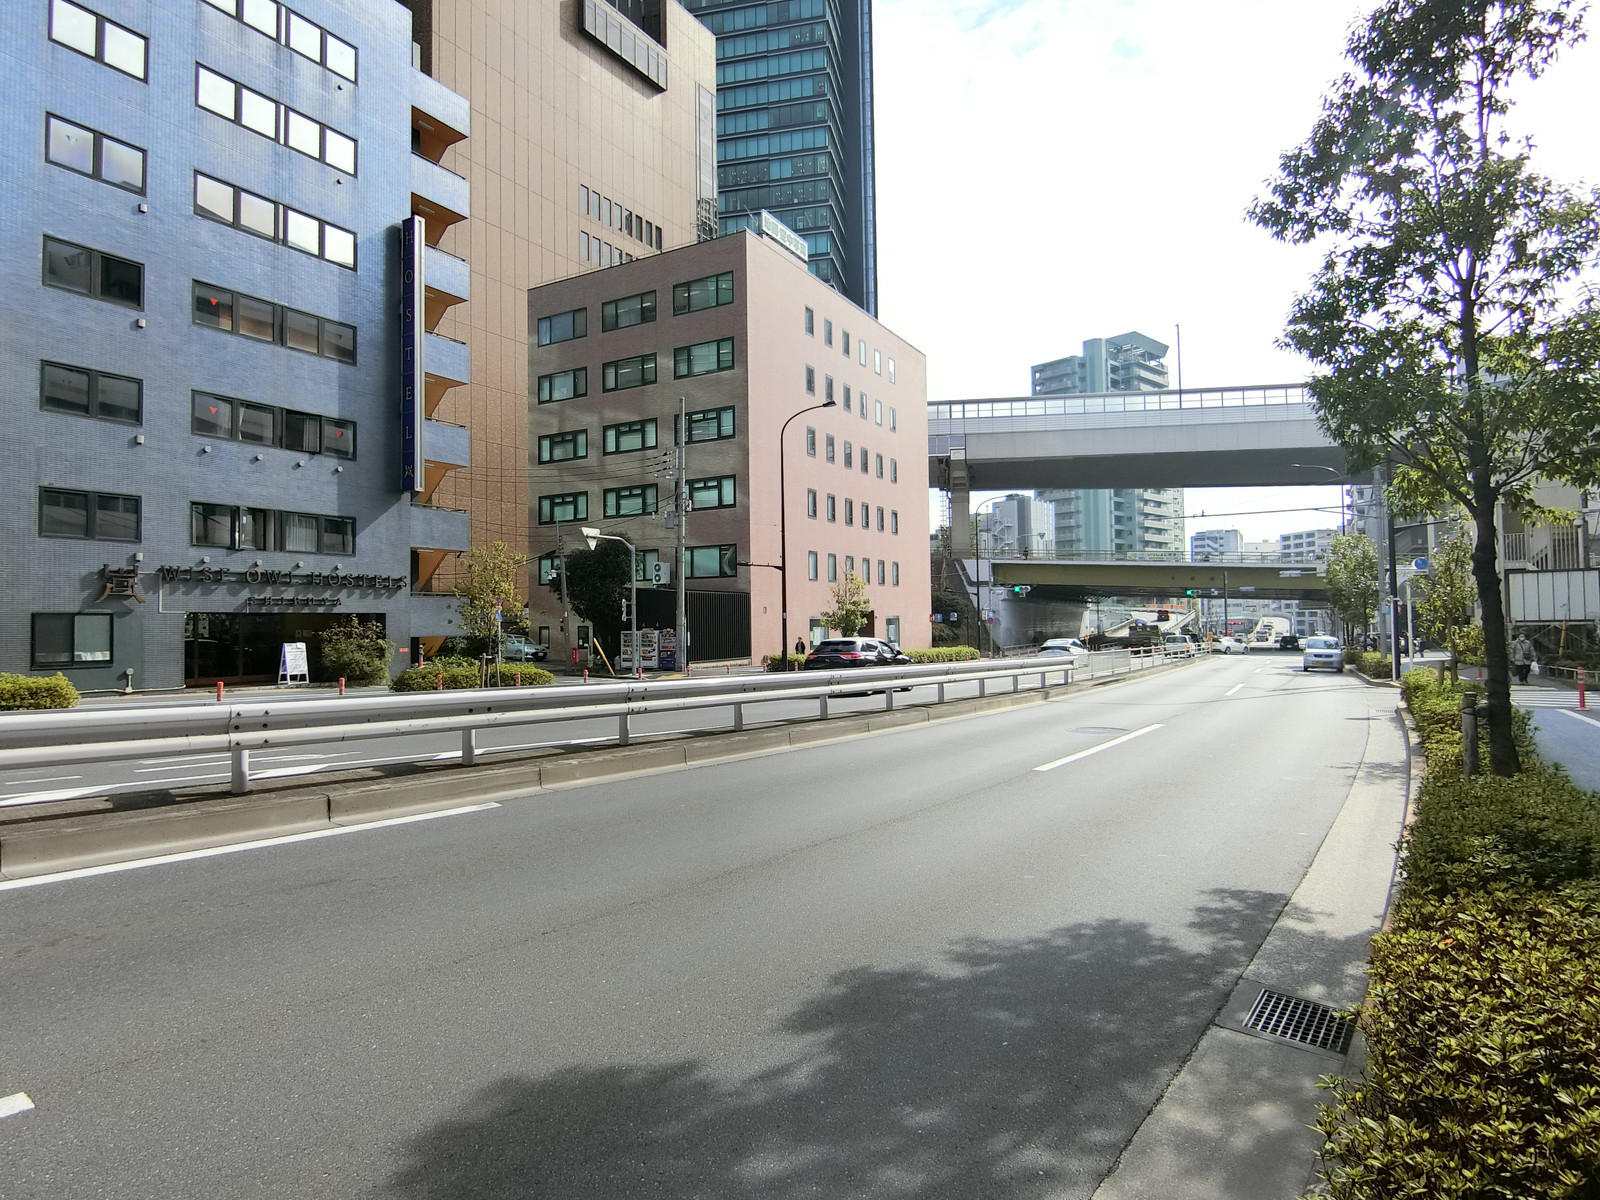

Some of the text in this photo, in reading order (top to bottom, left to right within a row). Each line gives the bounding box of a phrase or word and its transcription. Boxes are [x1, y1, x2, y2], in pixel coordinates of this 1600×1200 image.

[404, 230, 413, 440] HOSTEL
[160, 564, 408, 588] WISE OWL HOSTELS
[246, 596, 342, 606] SHIBUYA
